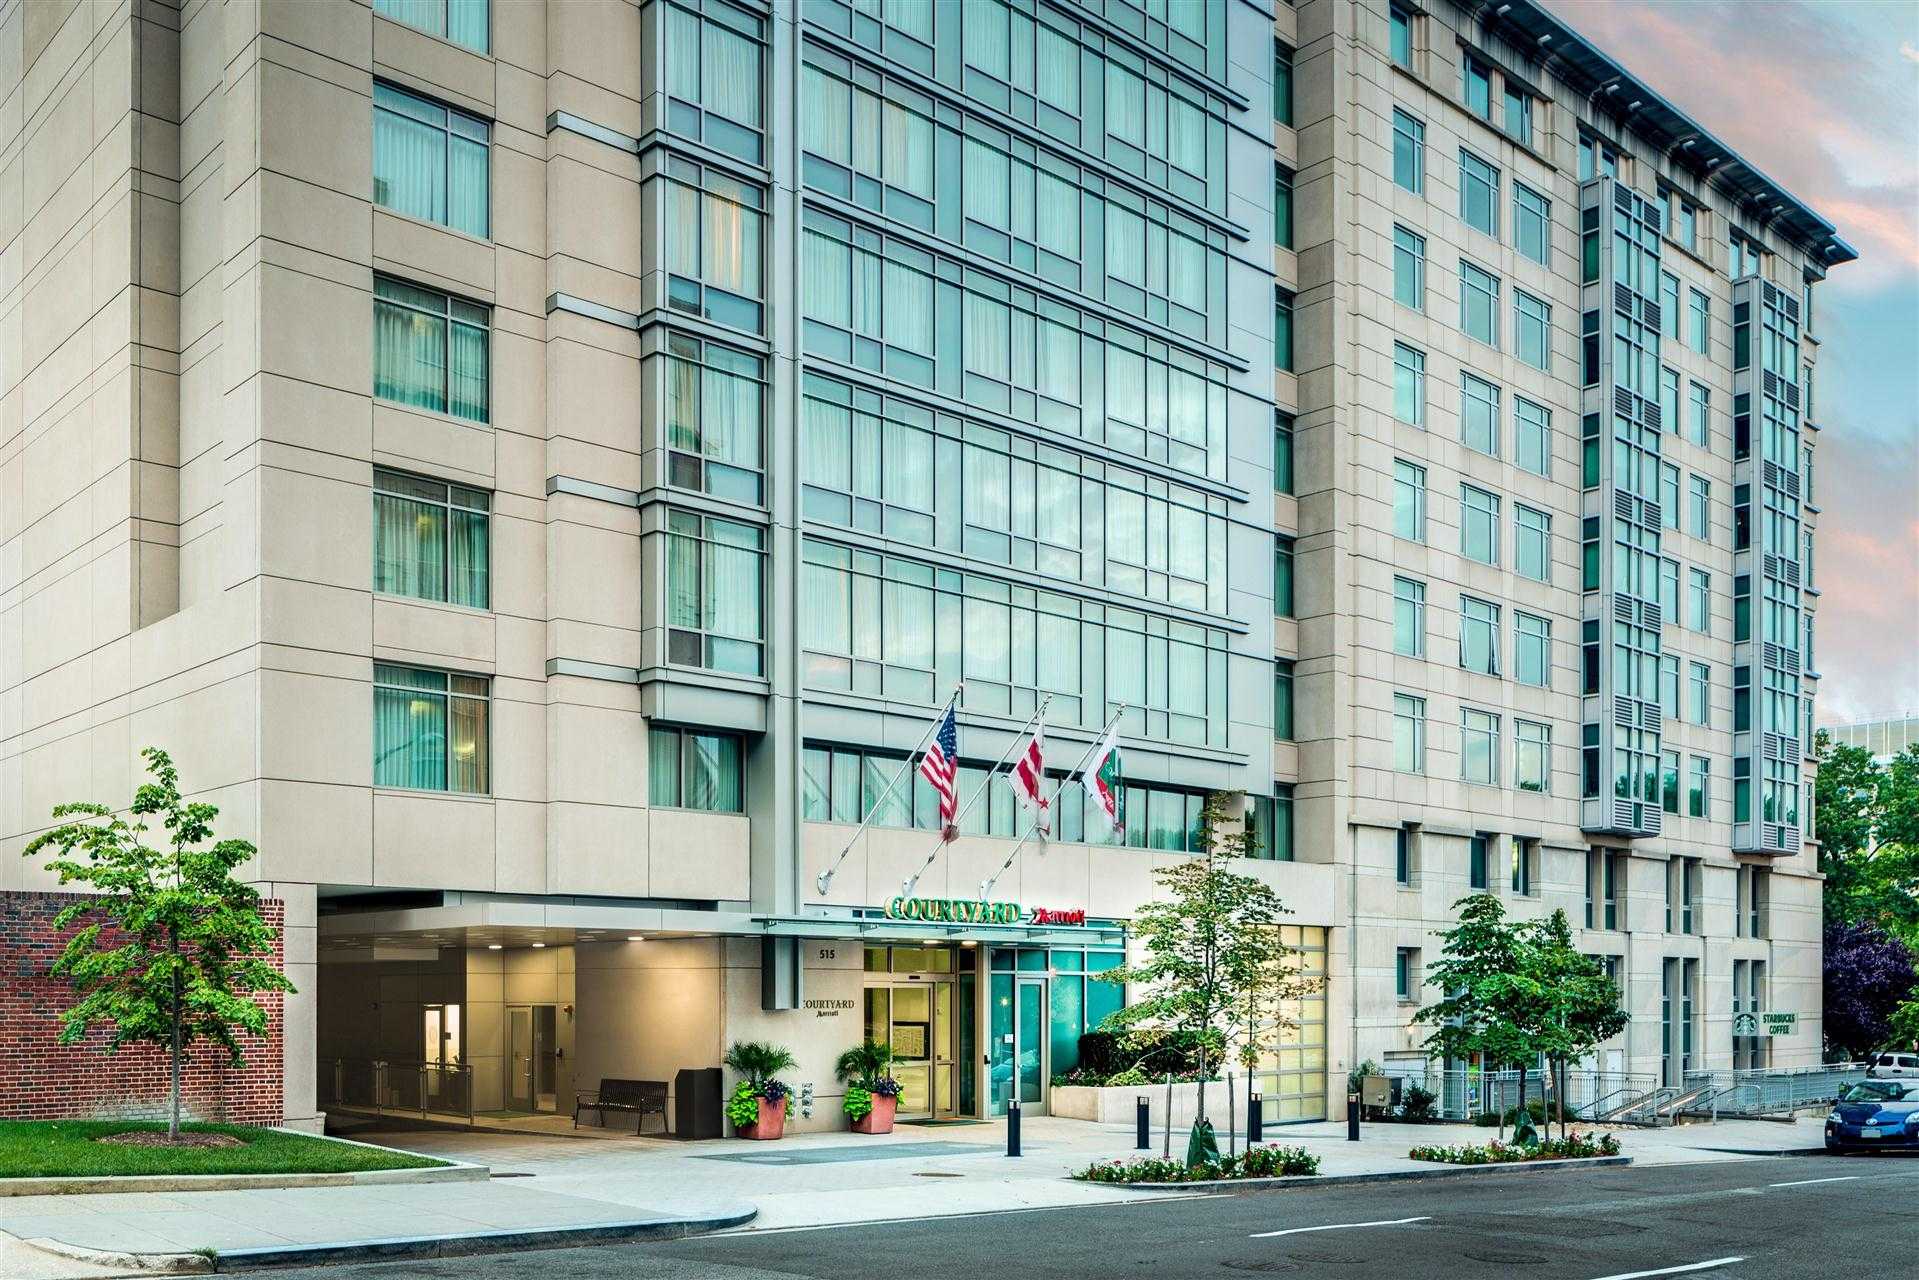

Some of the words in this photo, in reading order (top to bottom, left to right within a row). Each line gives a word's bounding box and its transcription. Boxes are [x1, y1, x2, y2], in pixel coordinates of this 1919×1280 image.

[884, 896, 1021, 923] COURTYARD
[819, 949, 835, 959] 515
[803, 999, 855, 1009] OURTYARD
[1763, 1013, 1795, 1023] STARBUCKS
[1769, 1025, 1790, 1035] COFFEE
